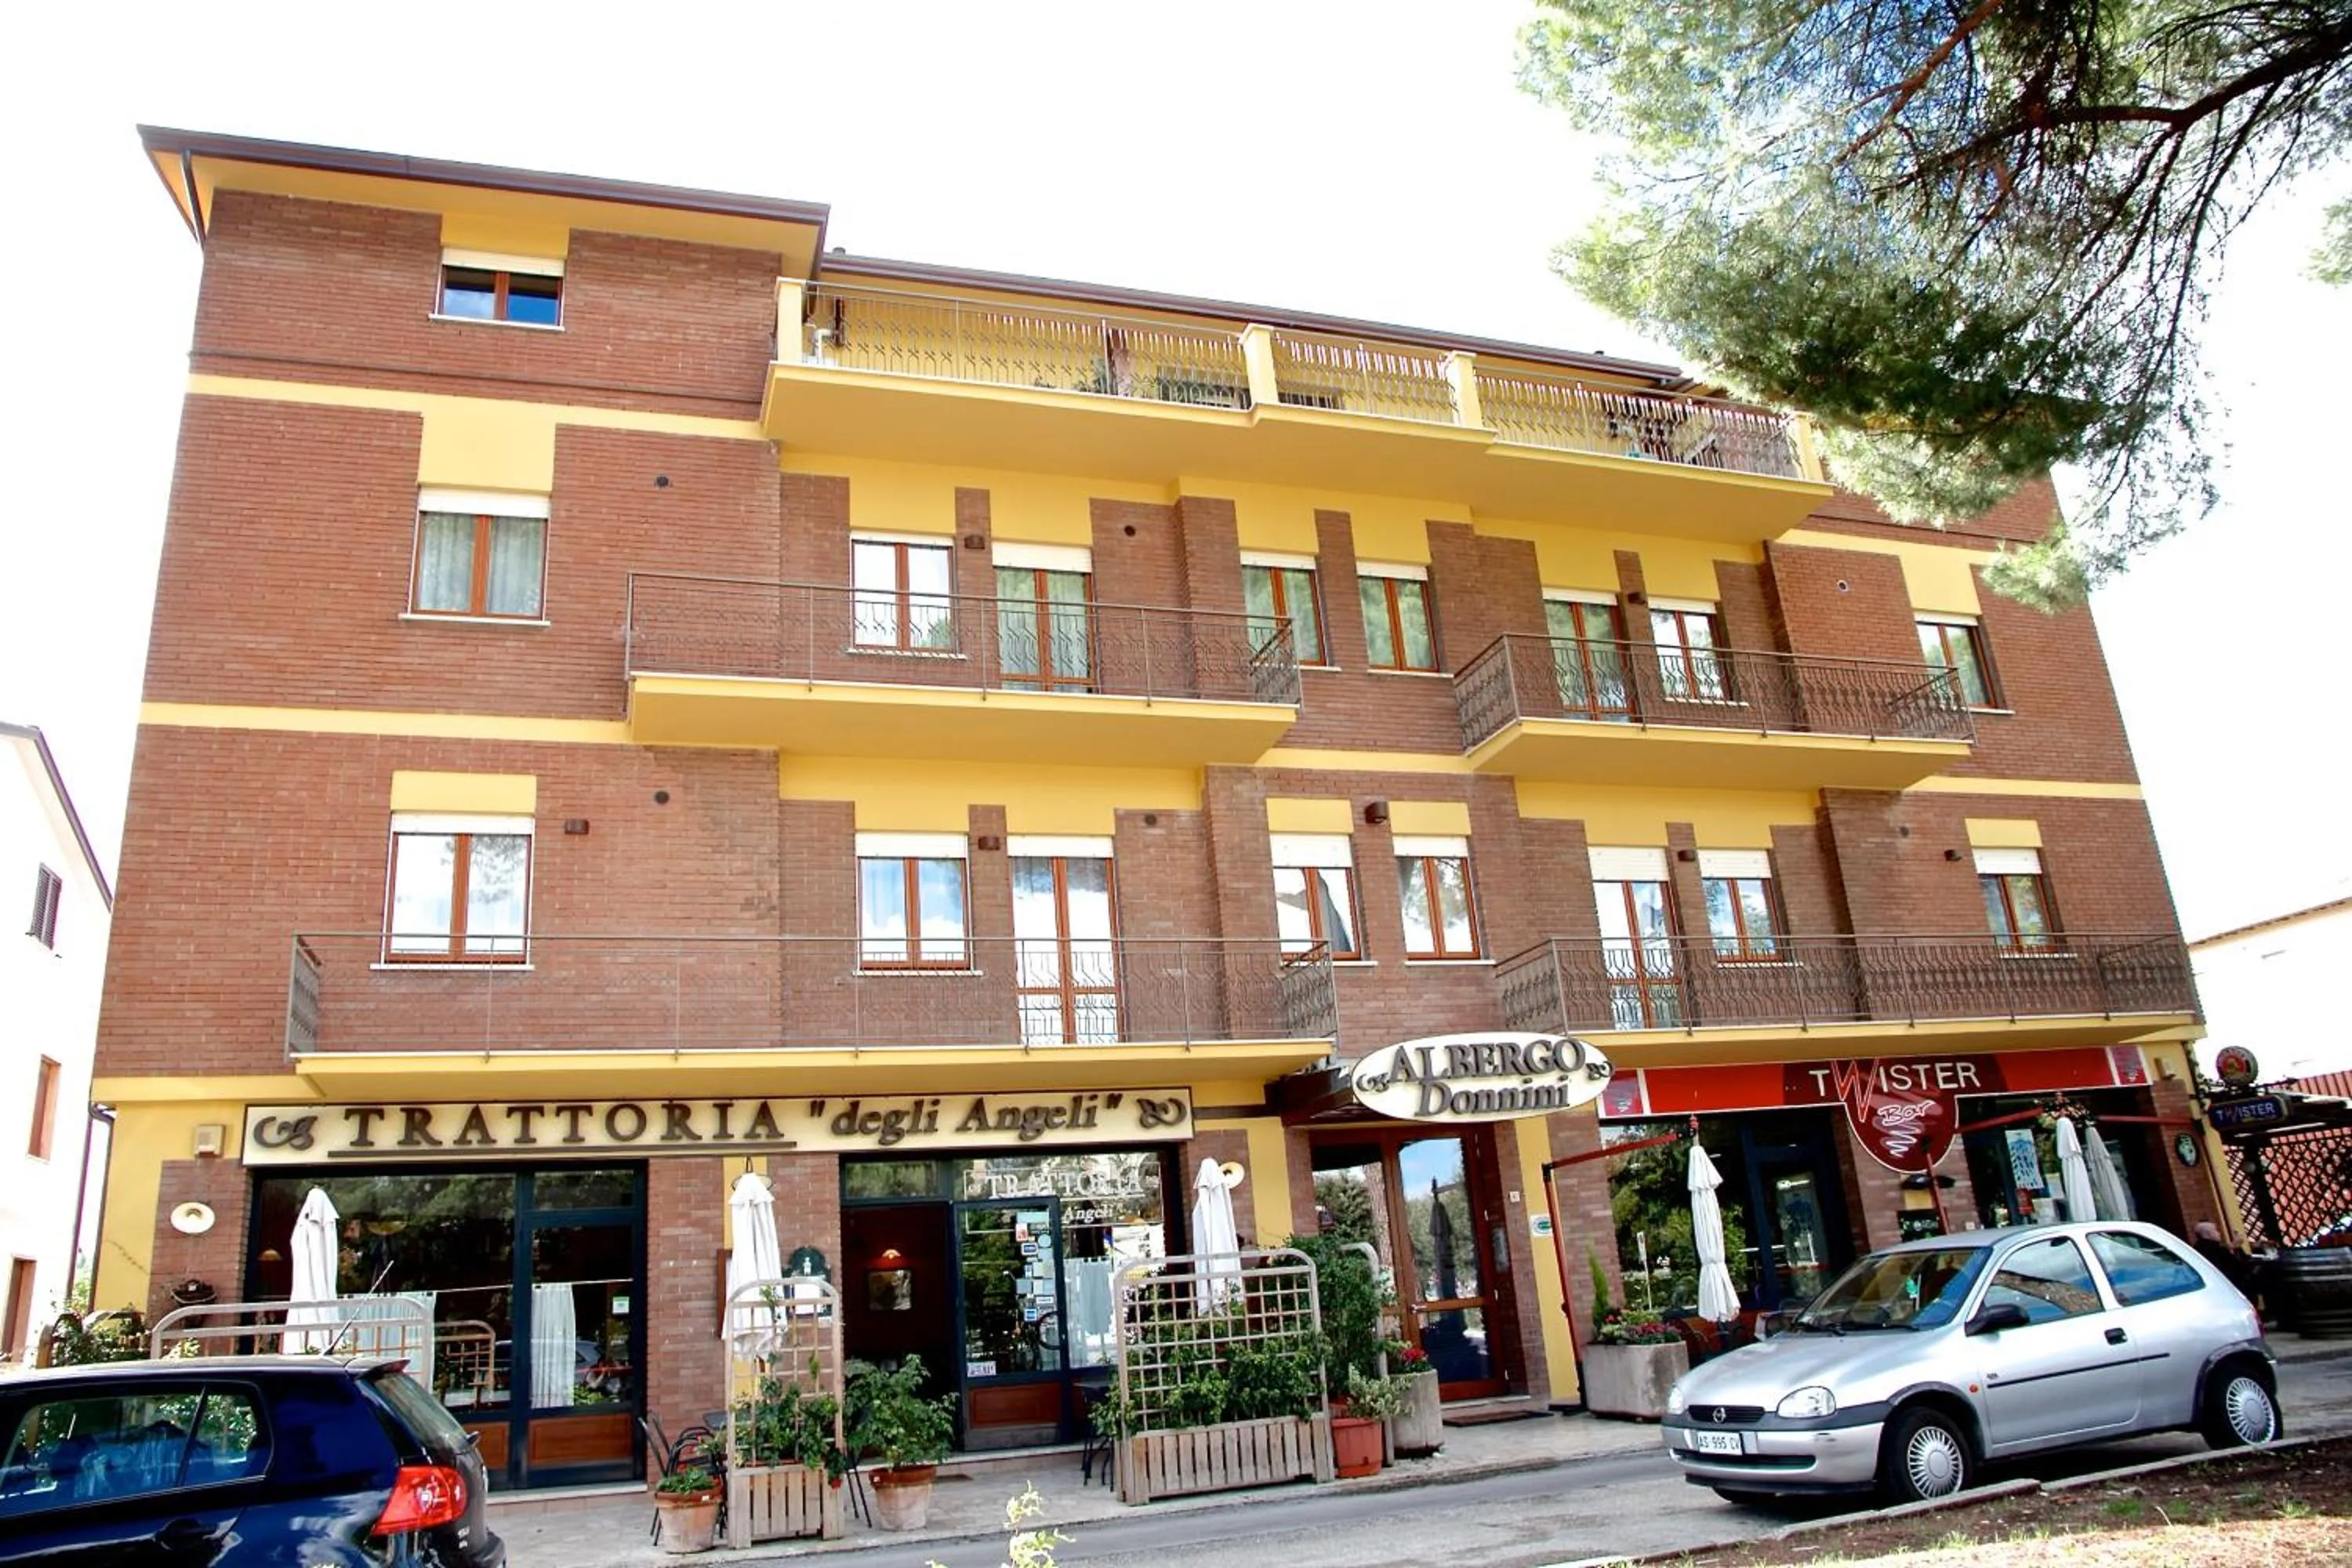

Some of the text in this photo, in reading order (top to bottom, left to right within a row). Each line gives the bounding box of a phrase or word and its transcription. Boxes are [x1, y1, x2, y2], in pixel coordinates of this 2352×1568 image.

[1390, 1038, 1585, 1082] ALBERGO
[1414, 1074, 1570, 1117] Donnini
[1808, 1058, 1982, 1123] TWISTER
[344, 1101, 785, 1146] TRATTORIA
[1878, 1099, 1936, 1127] Bar
[2216, 1102, 2275, 1123] TWISTER
[985, 1170, 1144, 1200] TRATTORIA
